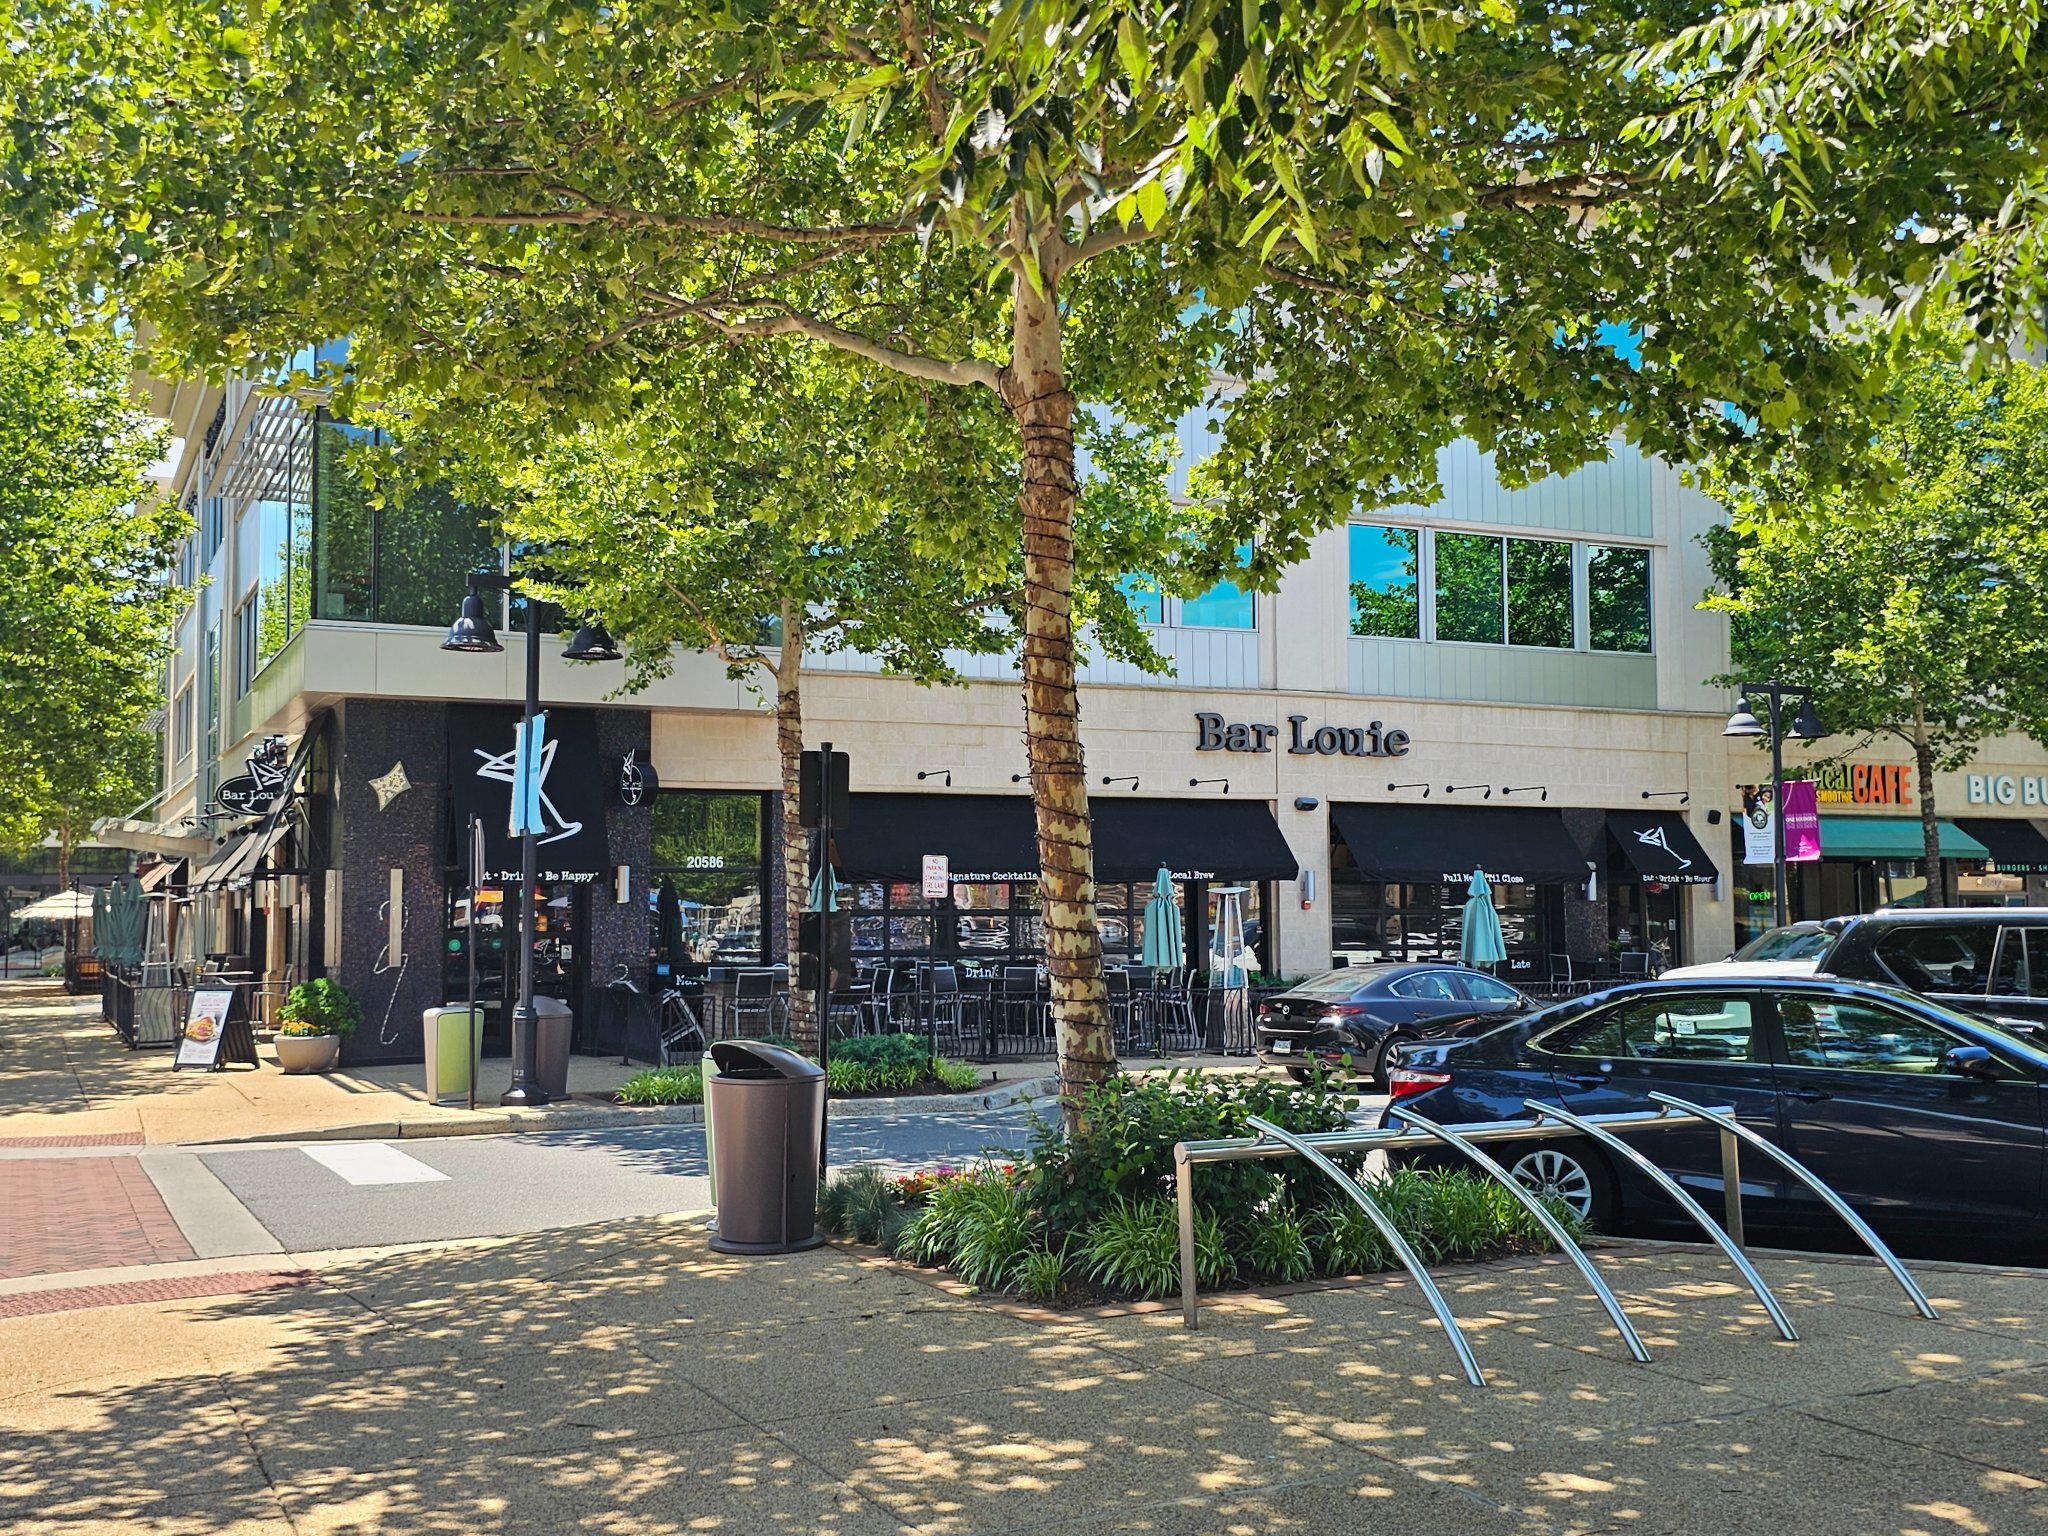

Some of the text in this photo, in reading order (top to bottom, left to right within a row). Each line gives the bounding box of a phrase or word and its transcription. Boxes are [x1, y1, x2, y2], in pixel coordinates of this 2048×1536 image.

[1195, 712, 1410, 757] Bar Louie
[1853, 763, 1912, 804] CAFE
[222, 789, 247, 801] Bar
[1968, 774, 2016, 805] BIG
[1816, 790, 1853, 803] SMOOTHIE
[686, 855, 724, 869] 20586
[501, 871, 524, 880] Dri
[545, 871, 559, 880] Be
[561, 871, 595, 882] Happy
[992, 872, 1038, 881] Cocktails
[1168, 870, 1215, 880] Local Brew
[1443, 873, 1462, 882] Full
[1501, 874, 1524, 883] Close
[1659, 875, 1680, 883] Drink
[1748, 891, 1771, 901] OPEN
[1511, 959, 1531, 969] Late
